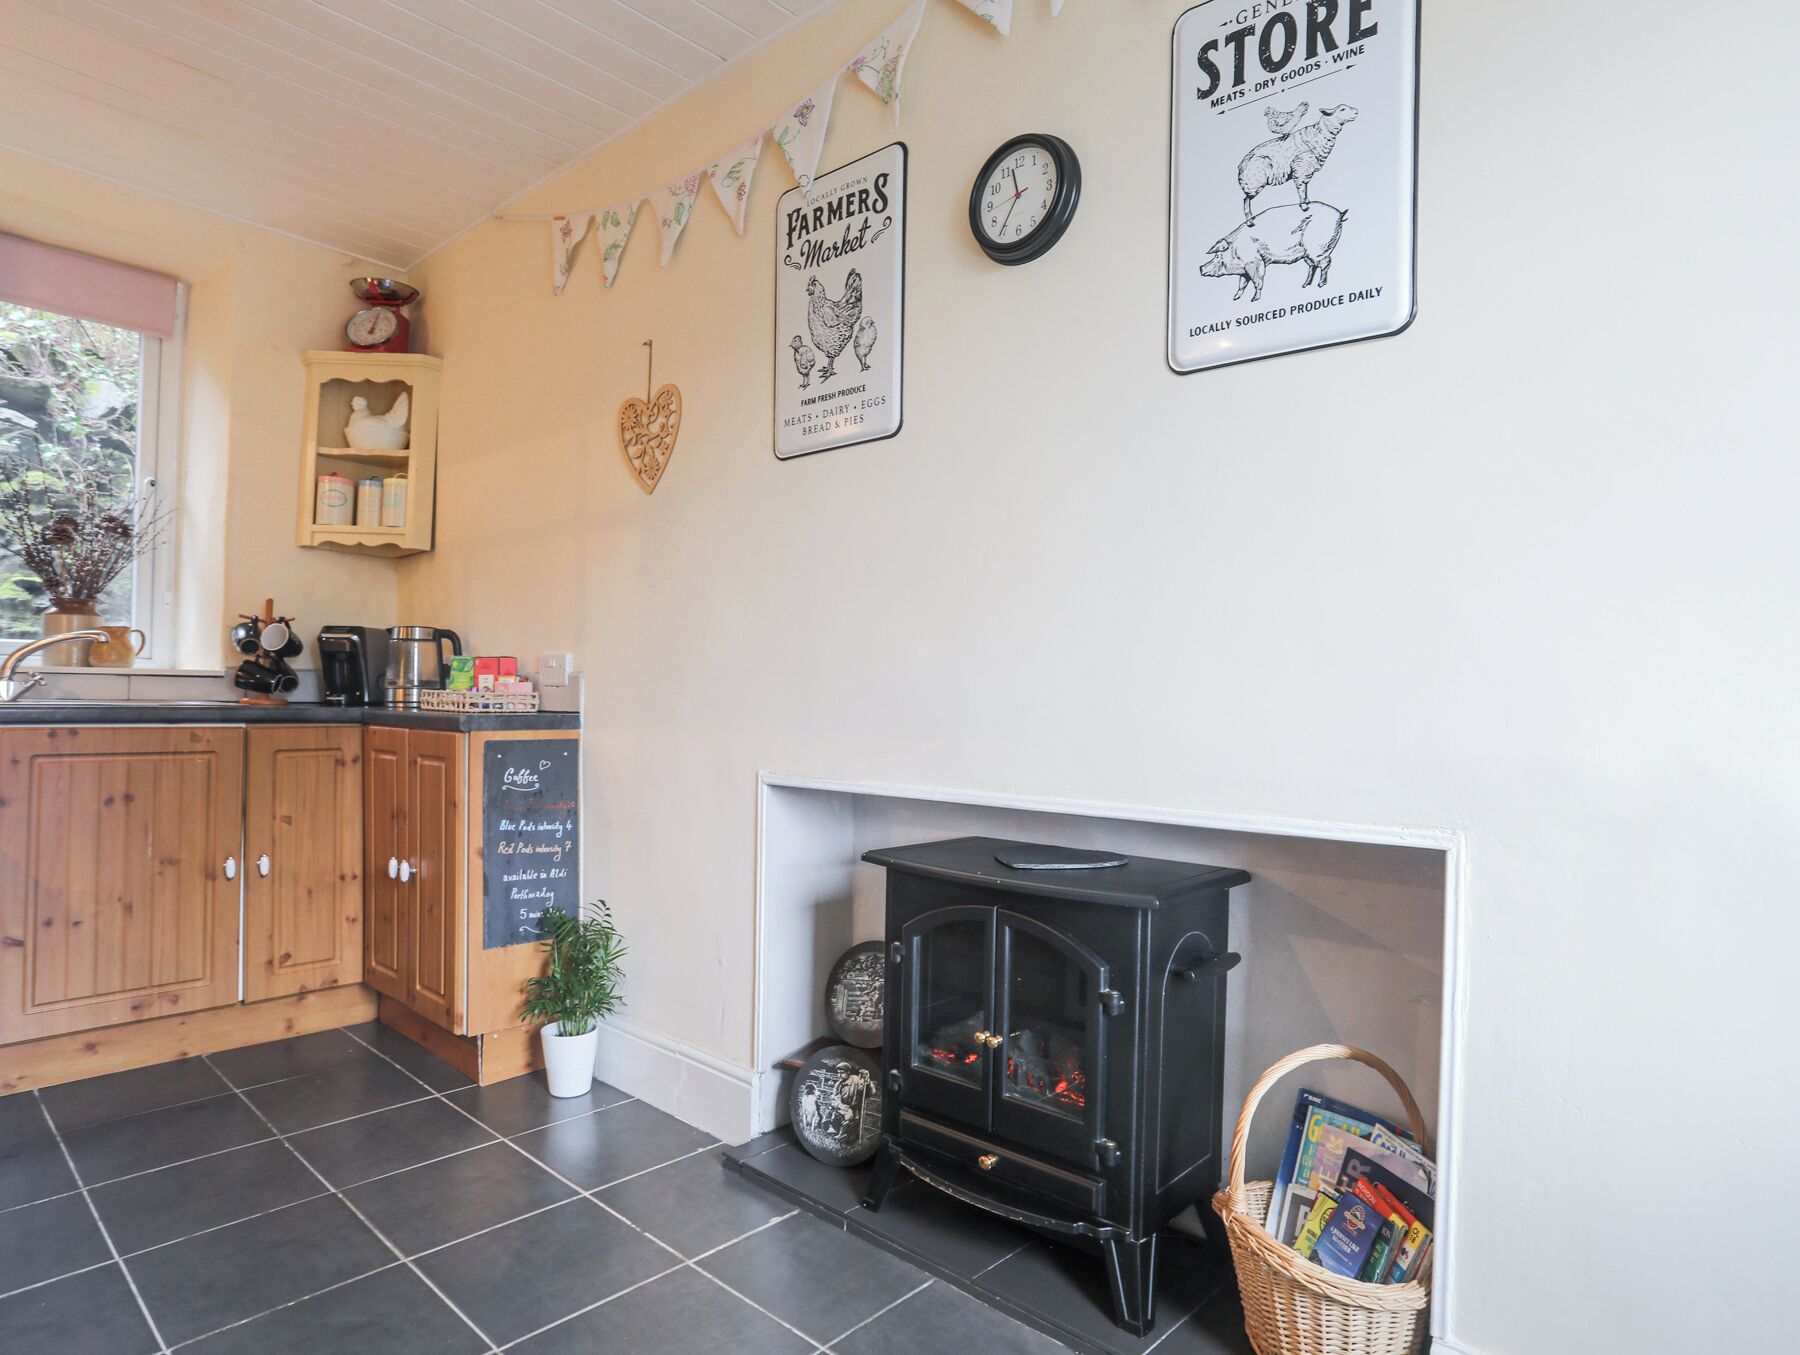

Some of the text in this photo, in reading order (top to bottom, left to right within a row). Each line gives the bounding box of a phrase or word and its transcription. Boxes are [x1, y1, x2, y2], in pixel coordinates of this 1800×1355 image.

[1197, 0, 1378, 100] STORE
[1210, 45, 1365, 109] MEATS DRY GOODS WINE
[1014, 156, 1025, 169] 12
[1031, 155, 1036, 166] 1
[1001, 167, 1011, 179] 11
[1042, 163, 1048, 175] 2
[990, 182, 1001, 196] 10
[1046, 179, 1052, 191] 3
[806, 177, 868, 207] LOCALLY GROWN
[786, 172, 890, 250] FARMERS
[987, 201, 993, 212] 9
[1041, 199, 1047, 210] 4
[991, 216, 998, 228] 8
[1030, 216, 1036, 228] 5
[1015, 225, 1022, 236] 6
[800, 216, 872, 270] Market
[1189, 286, 1383, 337] LOCALLY SOURCED PRODUCE DAILY
[800, 384, 867, 408] FARM FRESH PRODUCE
[784, 395, 886, 427] MEATS DAIRY EGGS
[802, 414, 865, 436] BREAD & PIES
[504, 767, 540, 784] Coffee
[499, 820, 516, 831] Blue
[519, 819, 536, 832] Pods
[566, 820, 573, 831] 4
[498, 841, 514, 854] Red
[516, 842, 533, 854] Pods
[565, 841, 573, 852] 7
[503, 869, 538, 882] available
[549, 868, 568, 879] Aldi
[520, 908, 528, 919] 5
